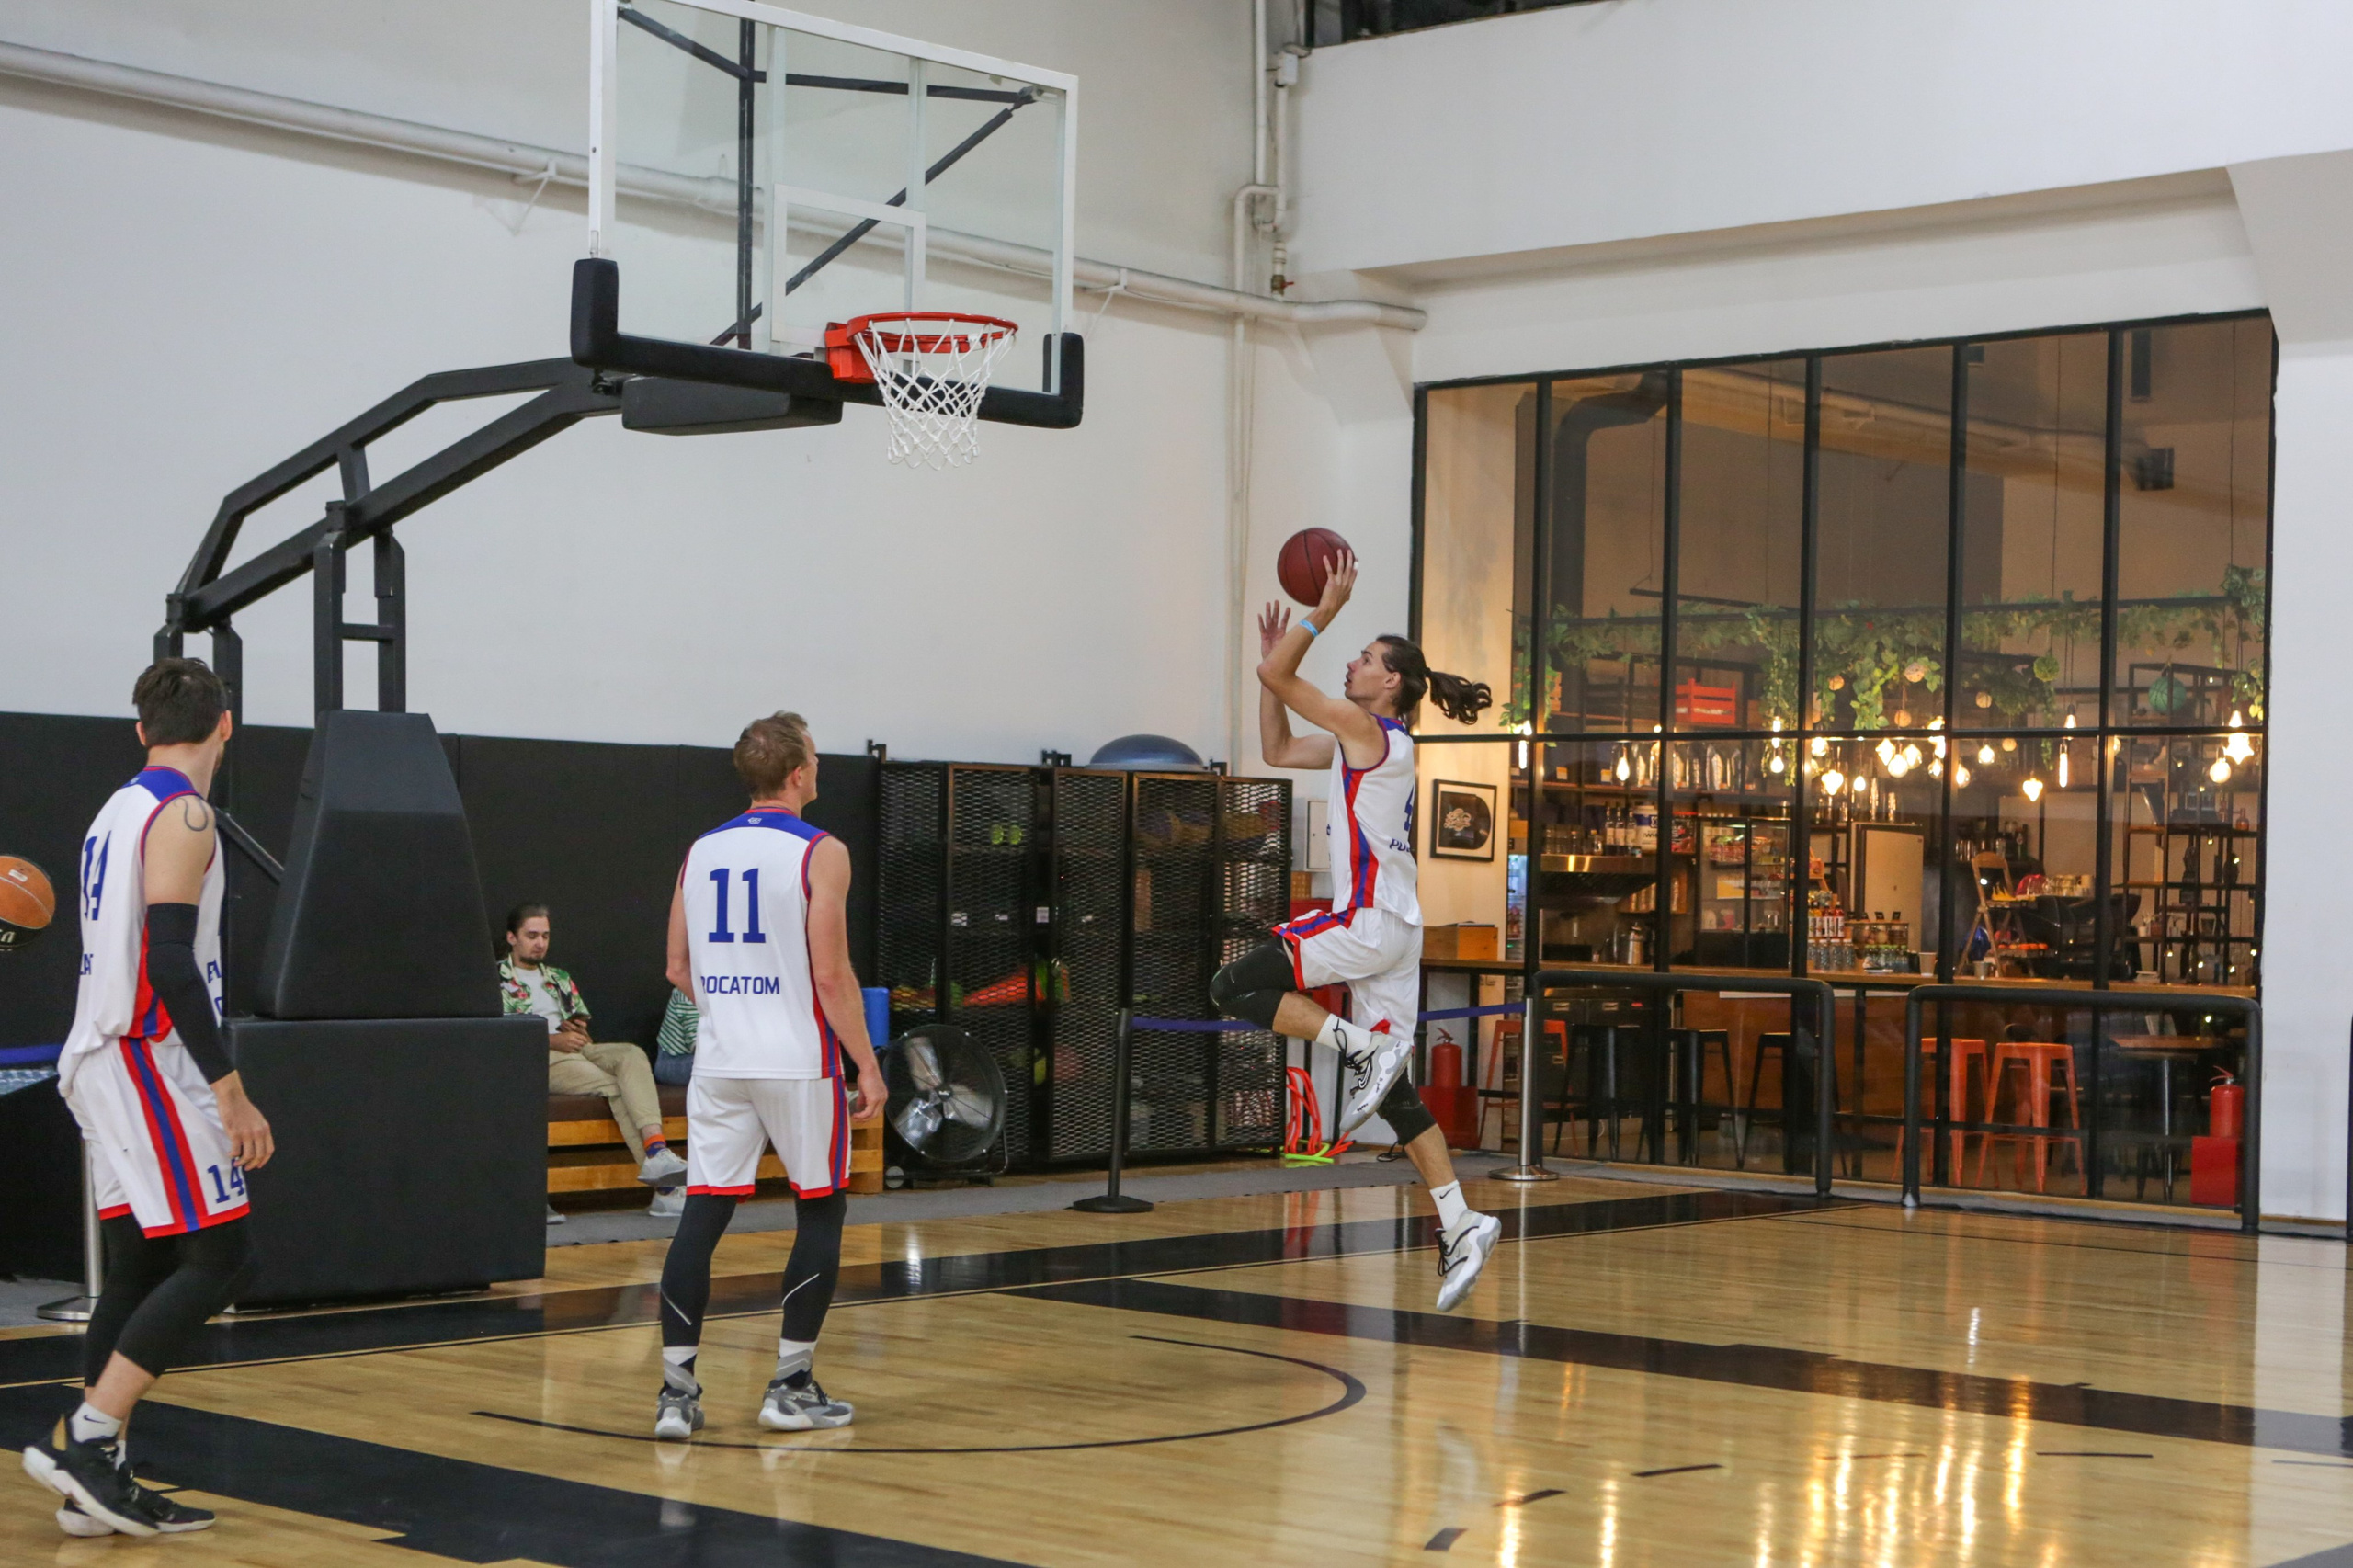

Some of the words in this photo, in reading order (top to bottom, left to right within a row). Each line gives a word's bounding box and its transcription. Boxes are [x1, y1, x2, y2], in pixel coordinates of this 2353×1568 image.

[84, 830, 112, 921] 14
[709, 868, 767, 944] 11
[207, 1158, 245, 1204] 14
